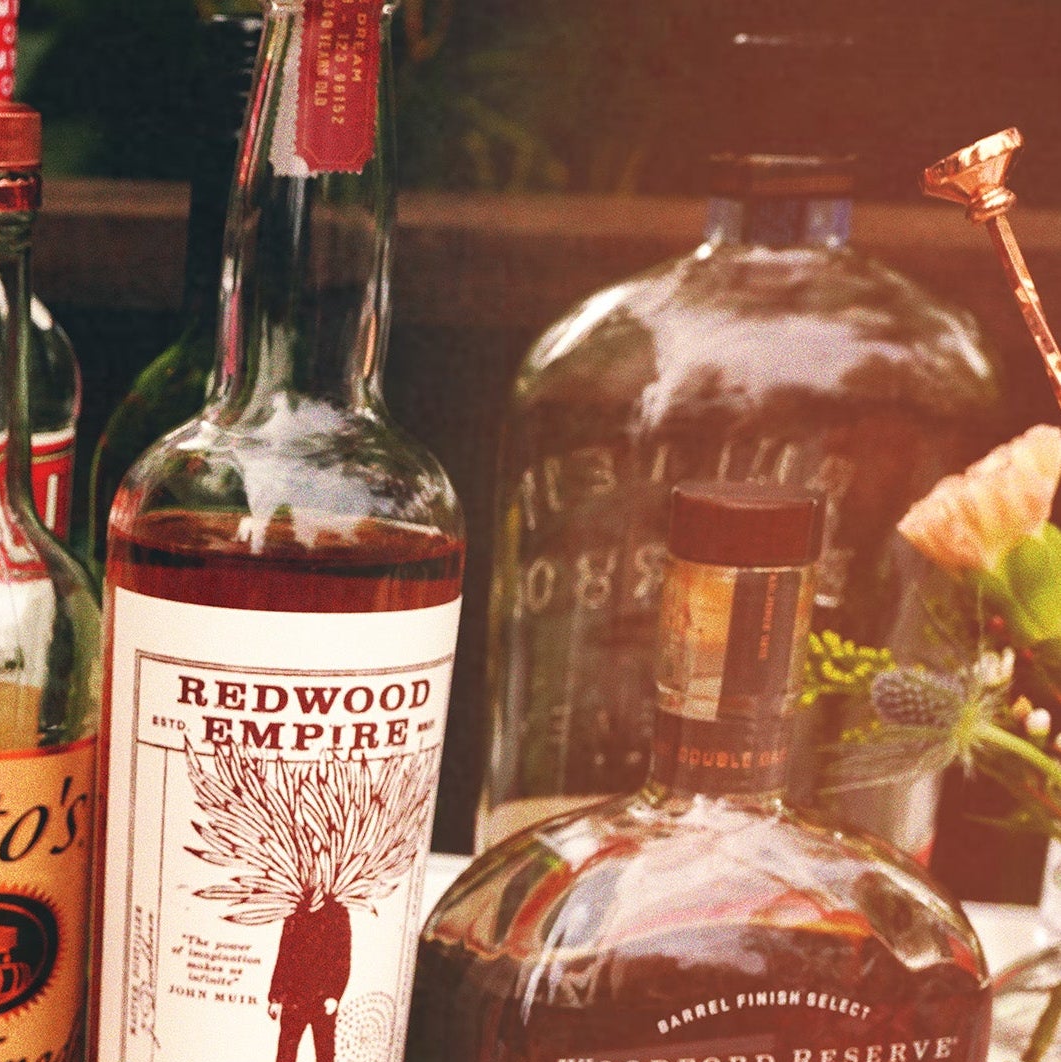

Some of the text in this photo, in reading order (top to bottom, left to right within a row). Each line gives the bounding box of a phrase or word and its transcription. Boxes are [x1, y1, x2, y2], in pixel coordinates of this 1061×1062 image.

[177, 675, 431, 715] REDWOOD
[202, 716, 409, 751] EMPIRE
[169, 984, 207, 999] JOHN
[657, 990, 872, 1034] BARREL FINISH SELECT
